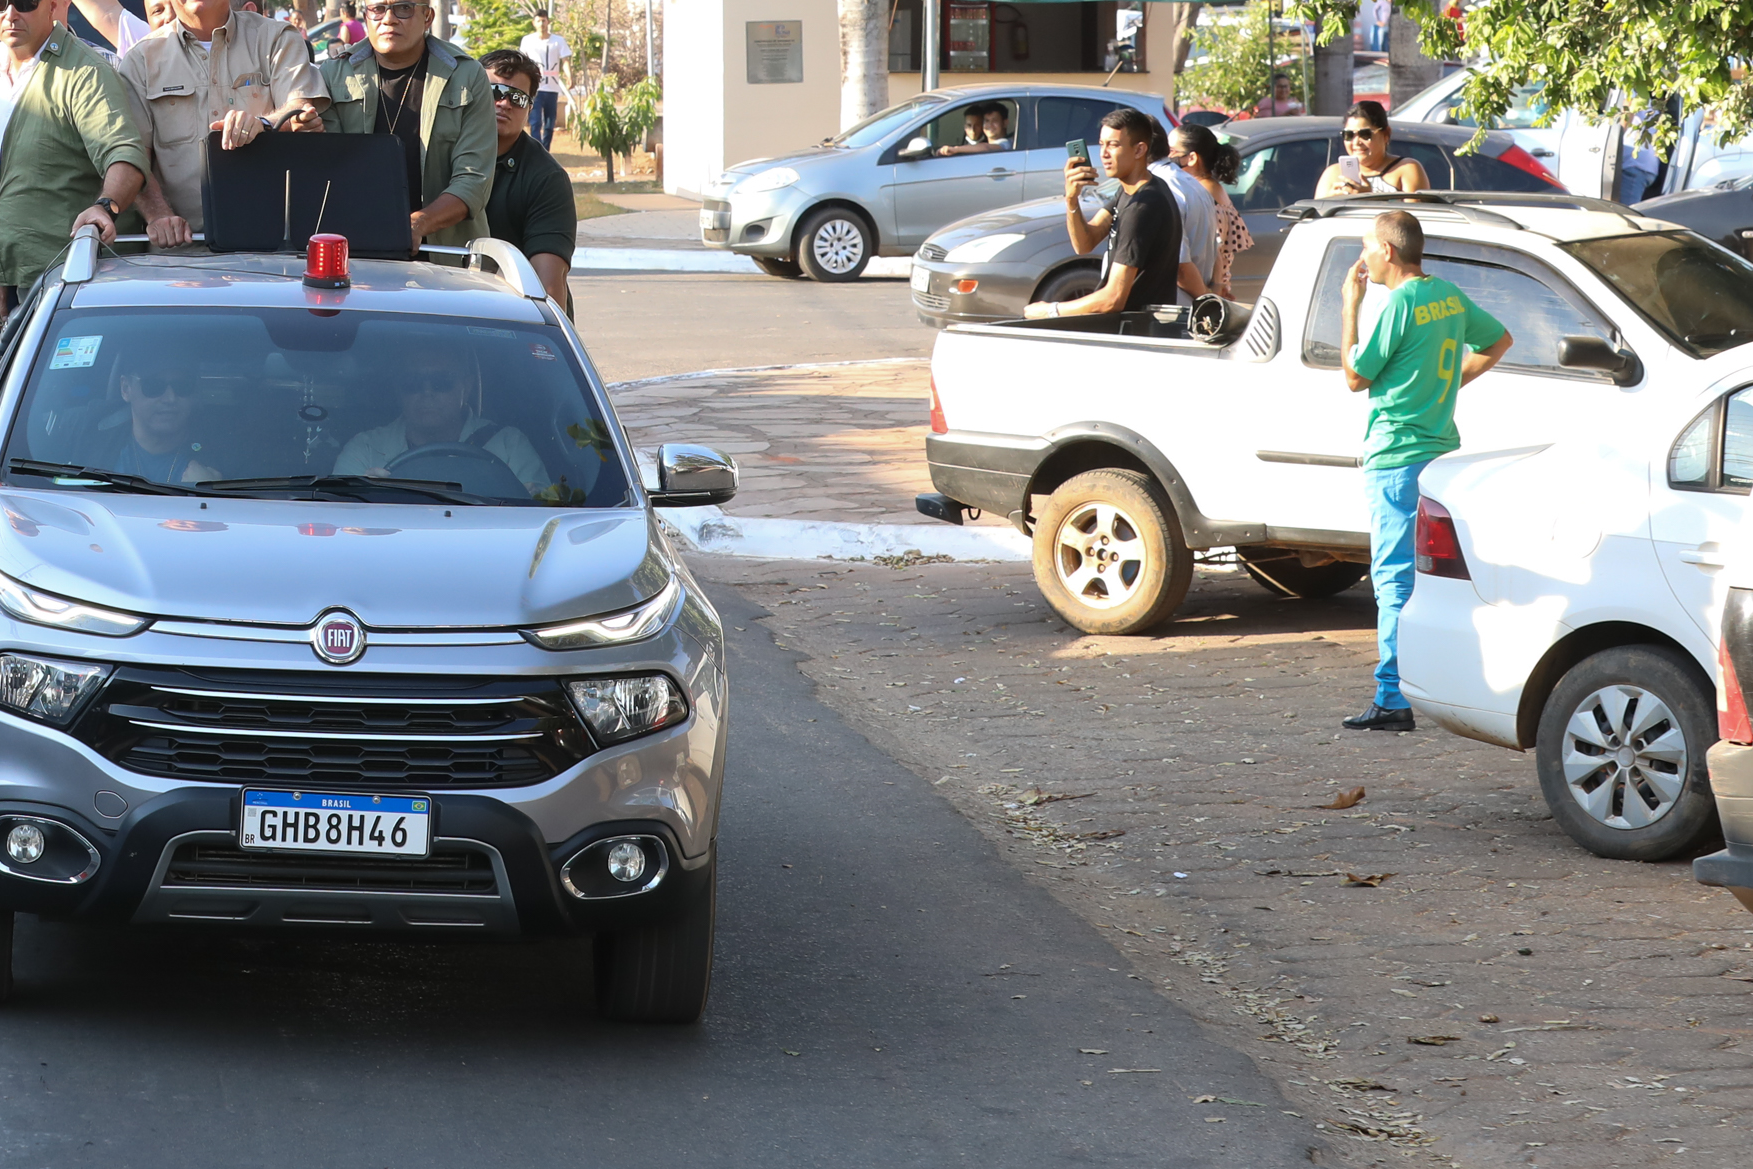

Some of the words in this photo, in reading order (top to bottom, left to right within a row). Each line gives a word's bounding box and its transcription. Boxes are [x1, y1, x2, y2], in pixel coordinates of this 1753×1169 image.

[1414, 296, 1465, 326] BRASIL
[1437, 338, 1457, 404] 9
[328, 628, 352, 648] FIAT
[322, 798, 351, 808] BRASIL
[245, 833, 255, 844] BR
[259, 809, 408, 848] GHB8H46
